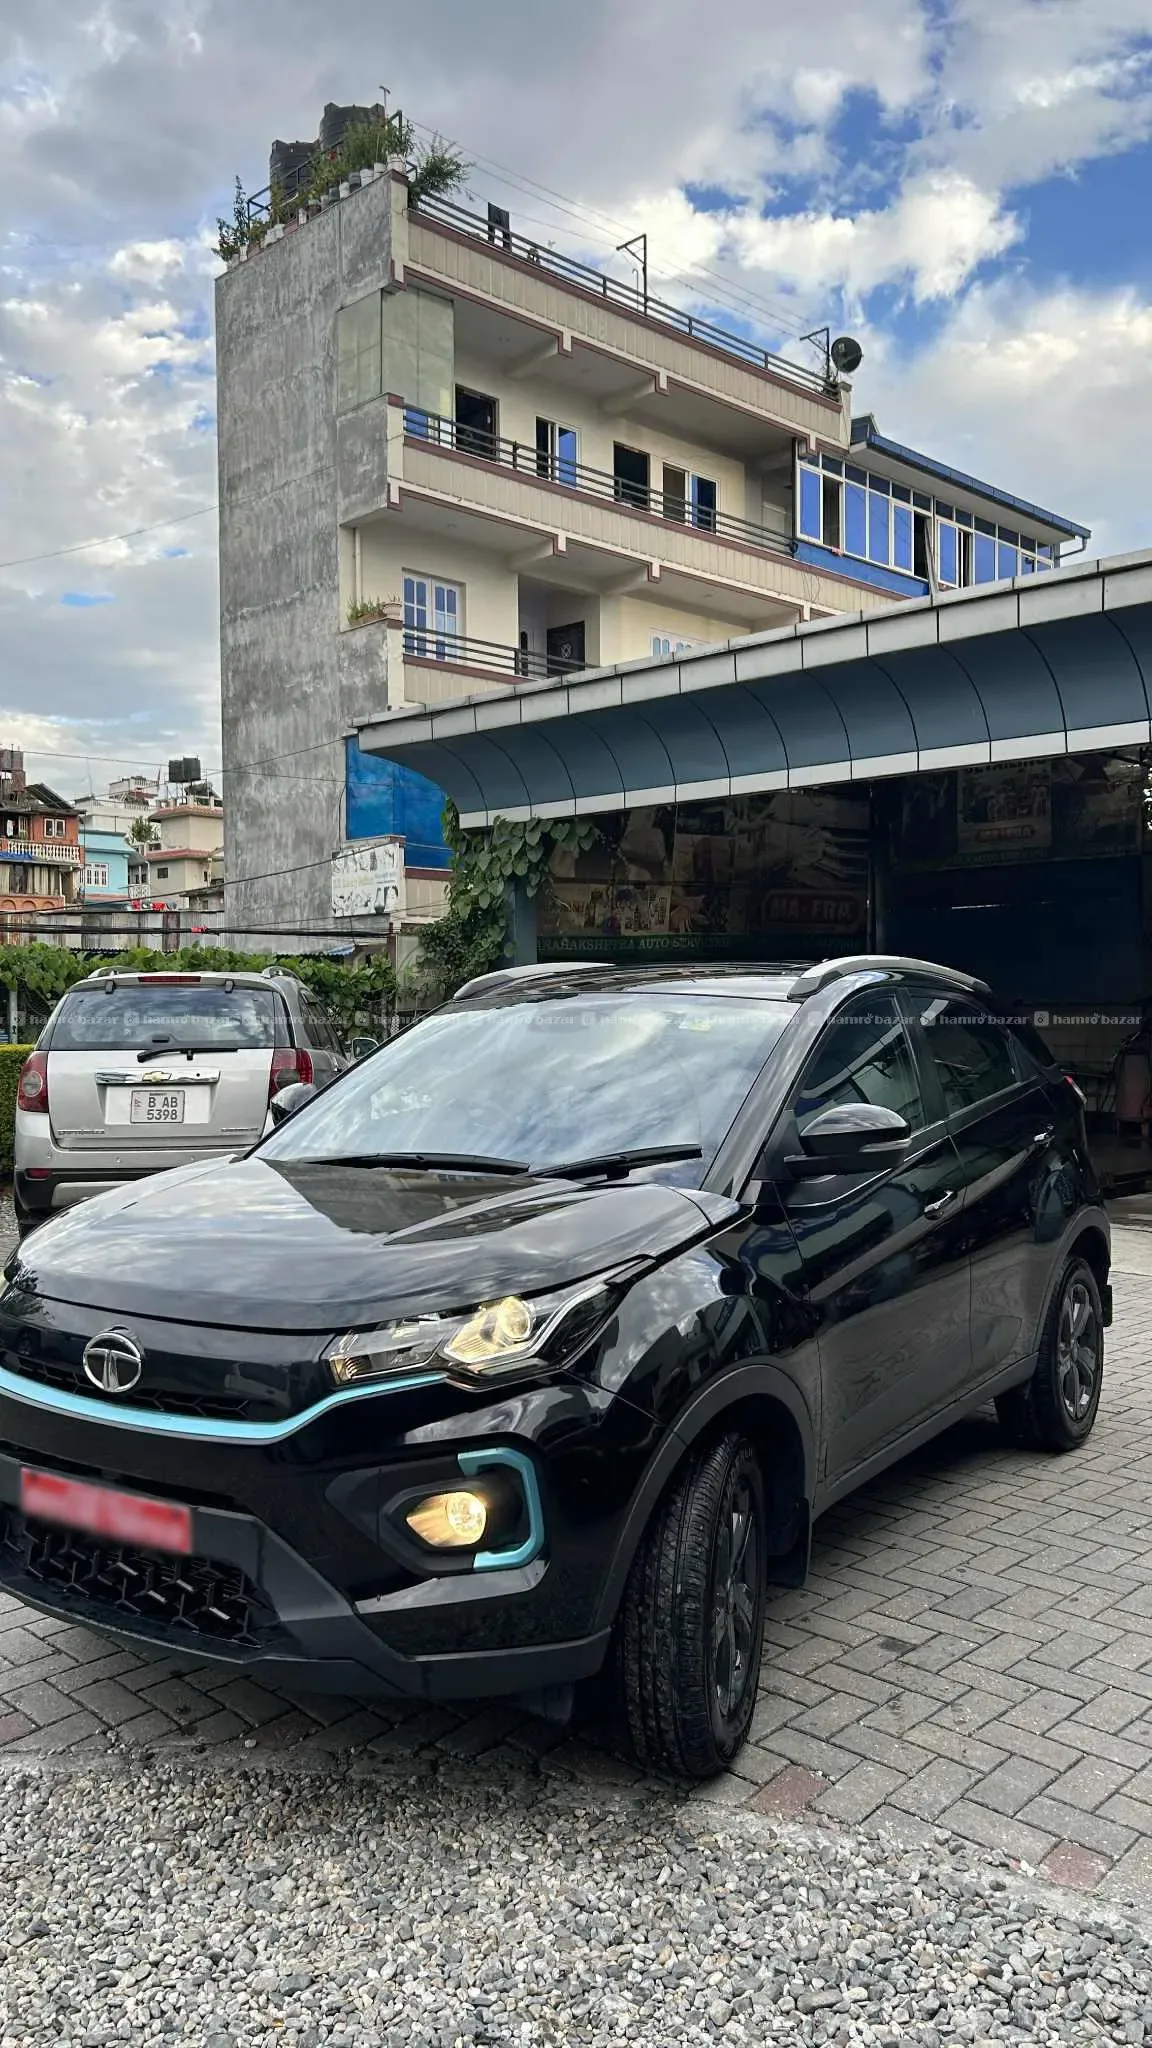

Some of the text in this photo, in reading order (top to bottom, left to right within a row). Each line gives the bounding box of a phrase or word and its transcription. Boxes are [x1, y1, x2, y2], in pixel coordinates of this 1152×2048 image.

[639, 937, 670, 949] AUTO
[149, 1097, 178, 1108] B AB
[147, 1109, 178, 1120] 5398
